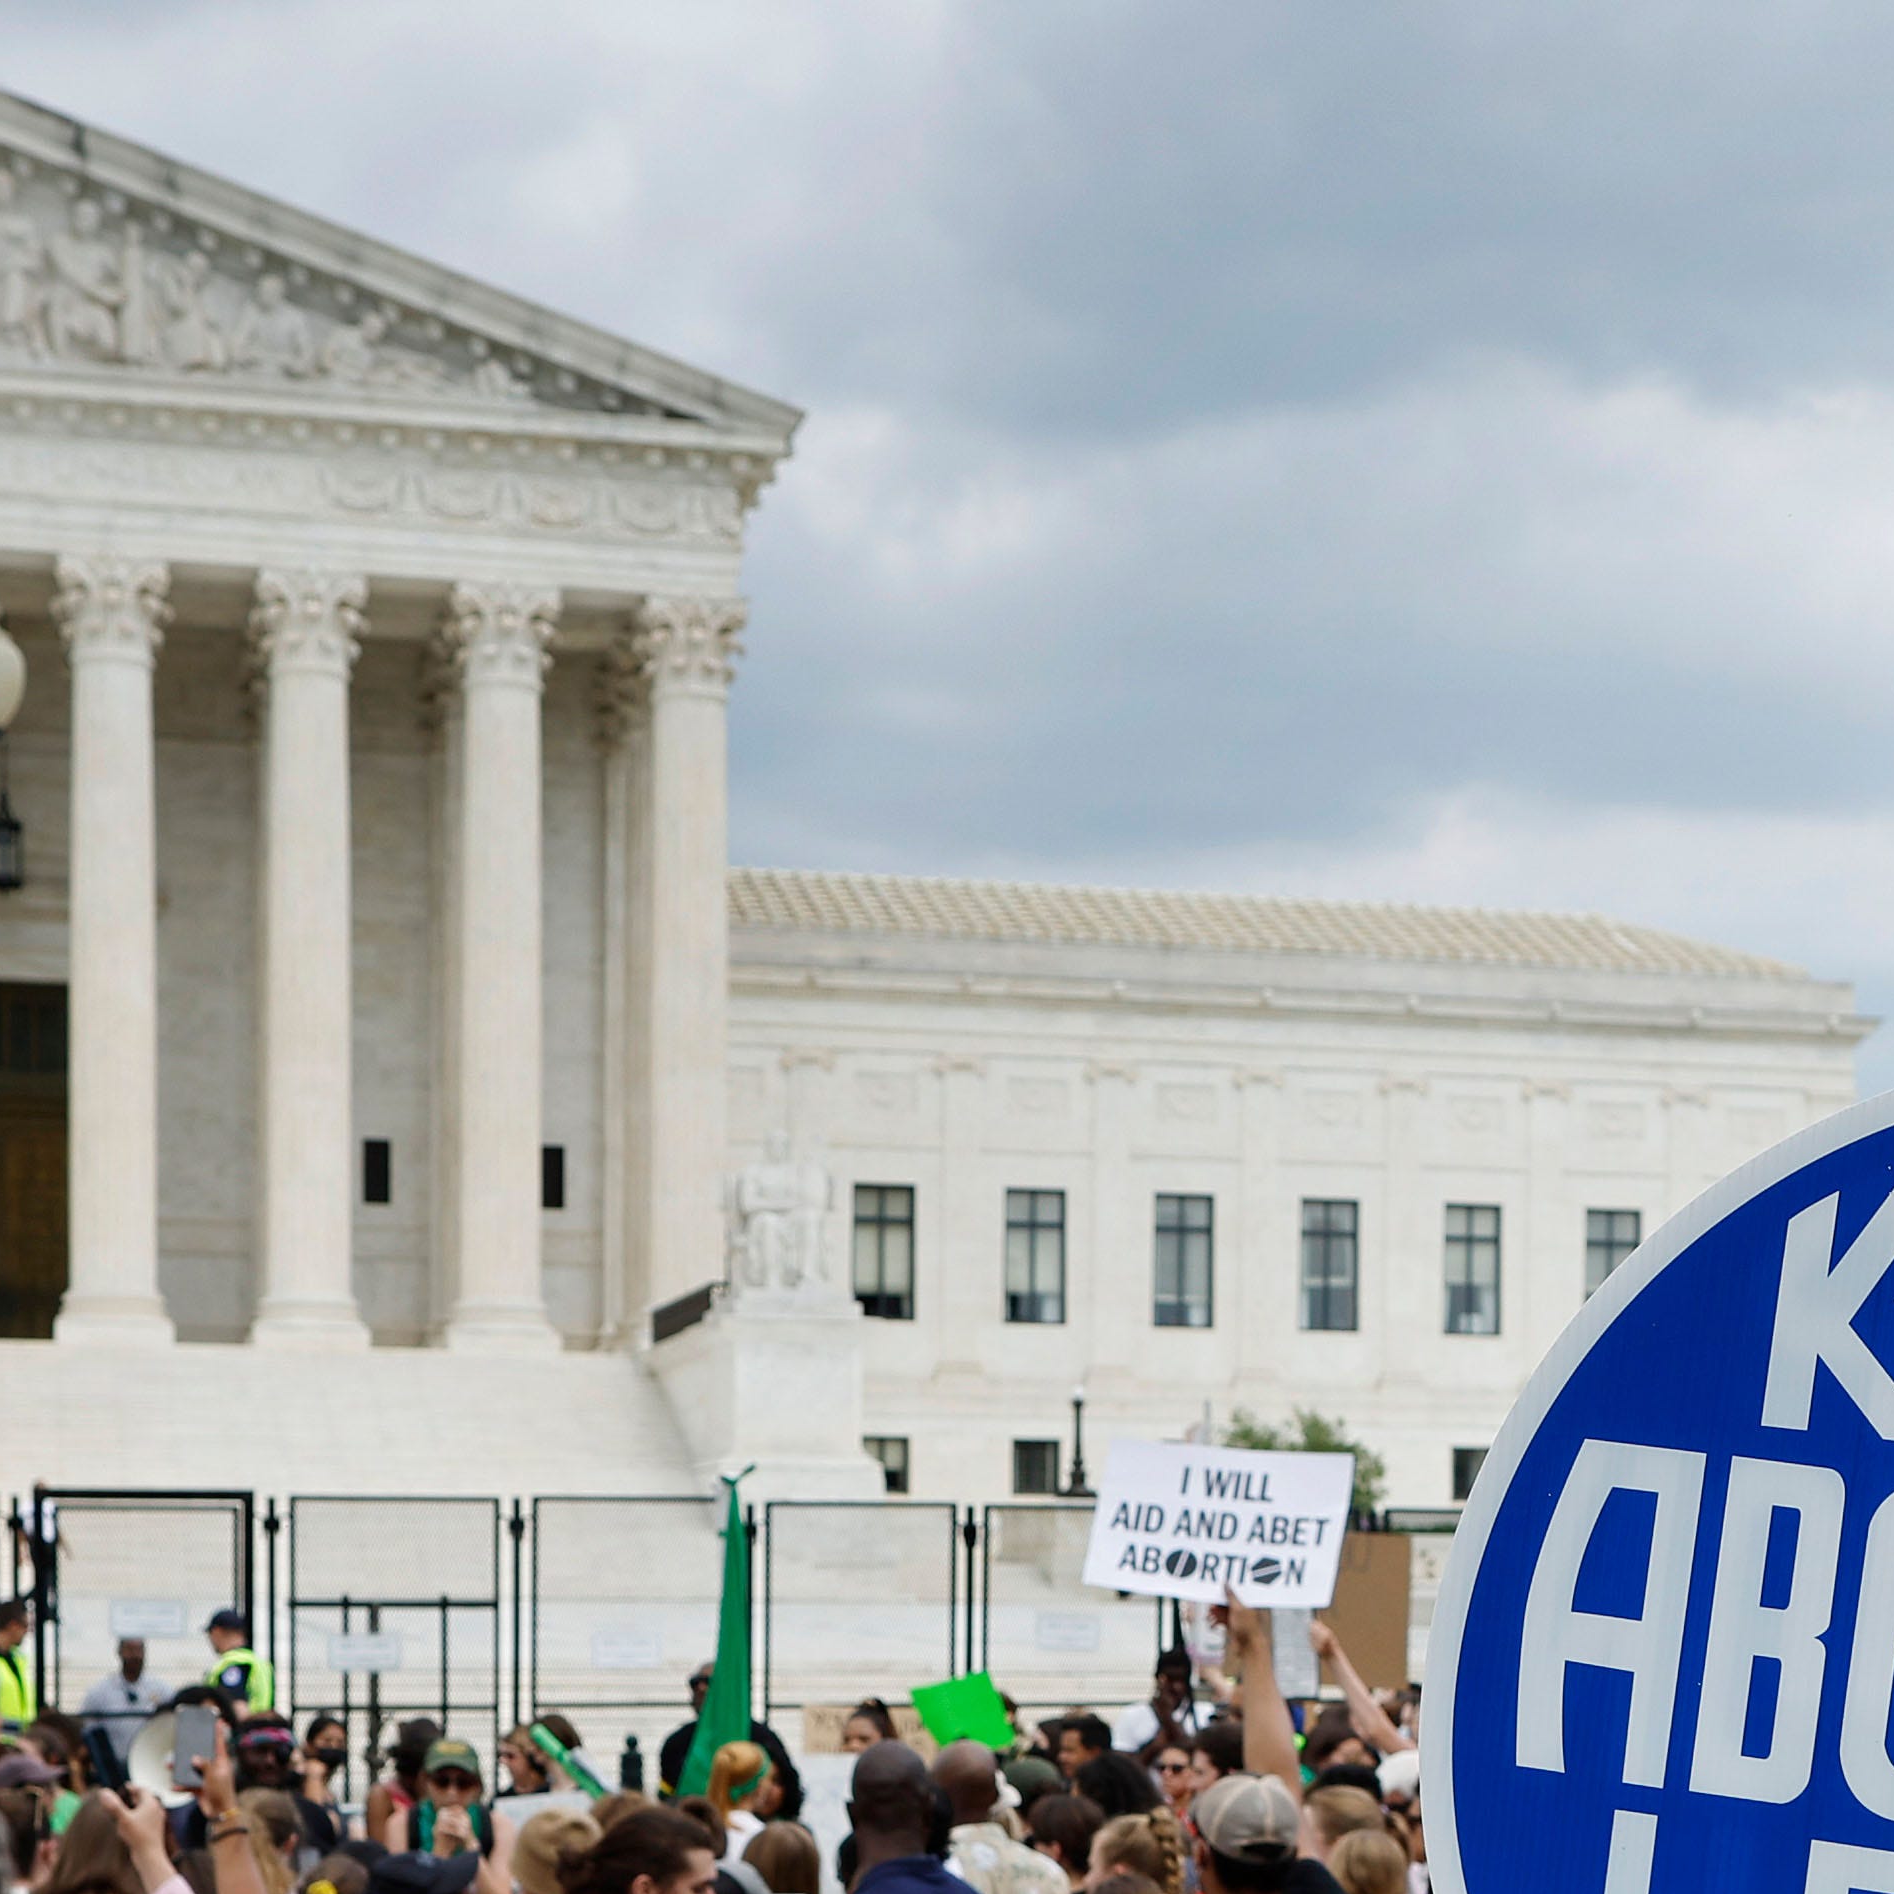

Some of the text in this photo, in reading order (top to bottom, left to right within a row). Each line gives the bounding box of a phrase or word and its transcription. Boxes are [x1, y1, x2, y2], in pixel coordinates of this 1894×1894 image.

[1180, 1466, 1274, 1502] I WILL
[1111, 1502, 1330, 1546] AID AND ABET
